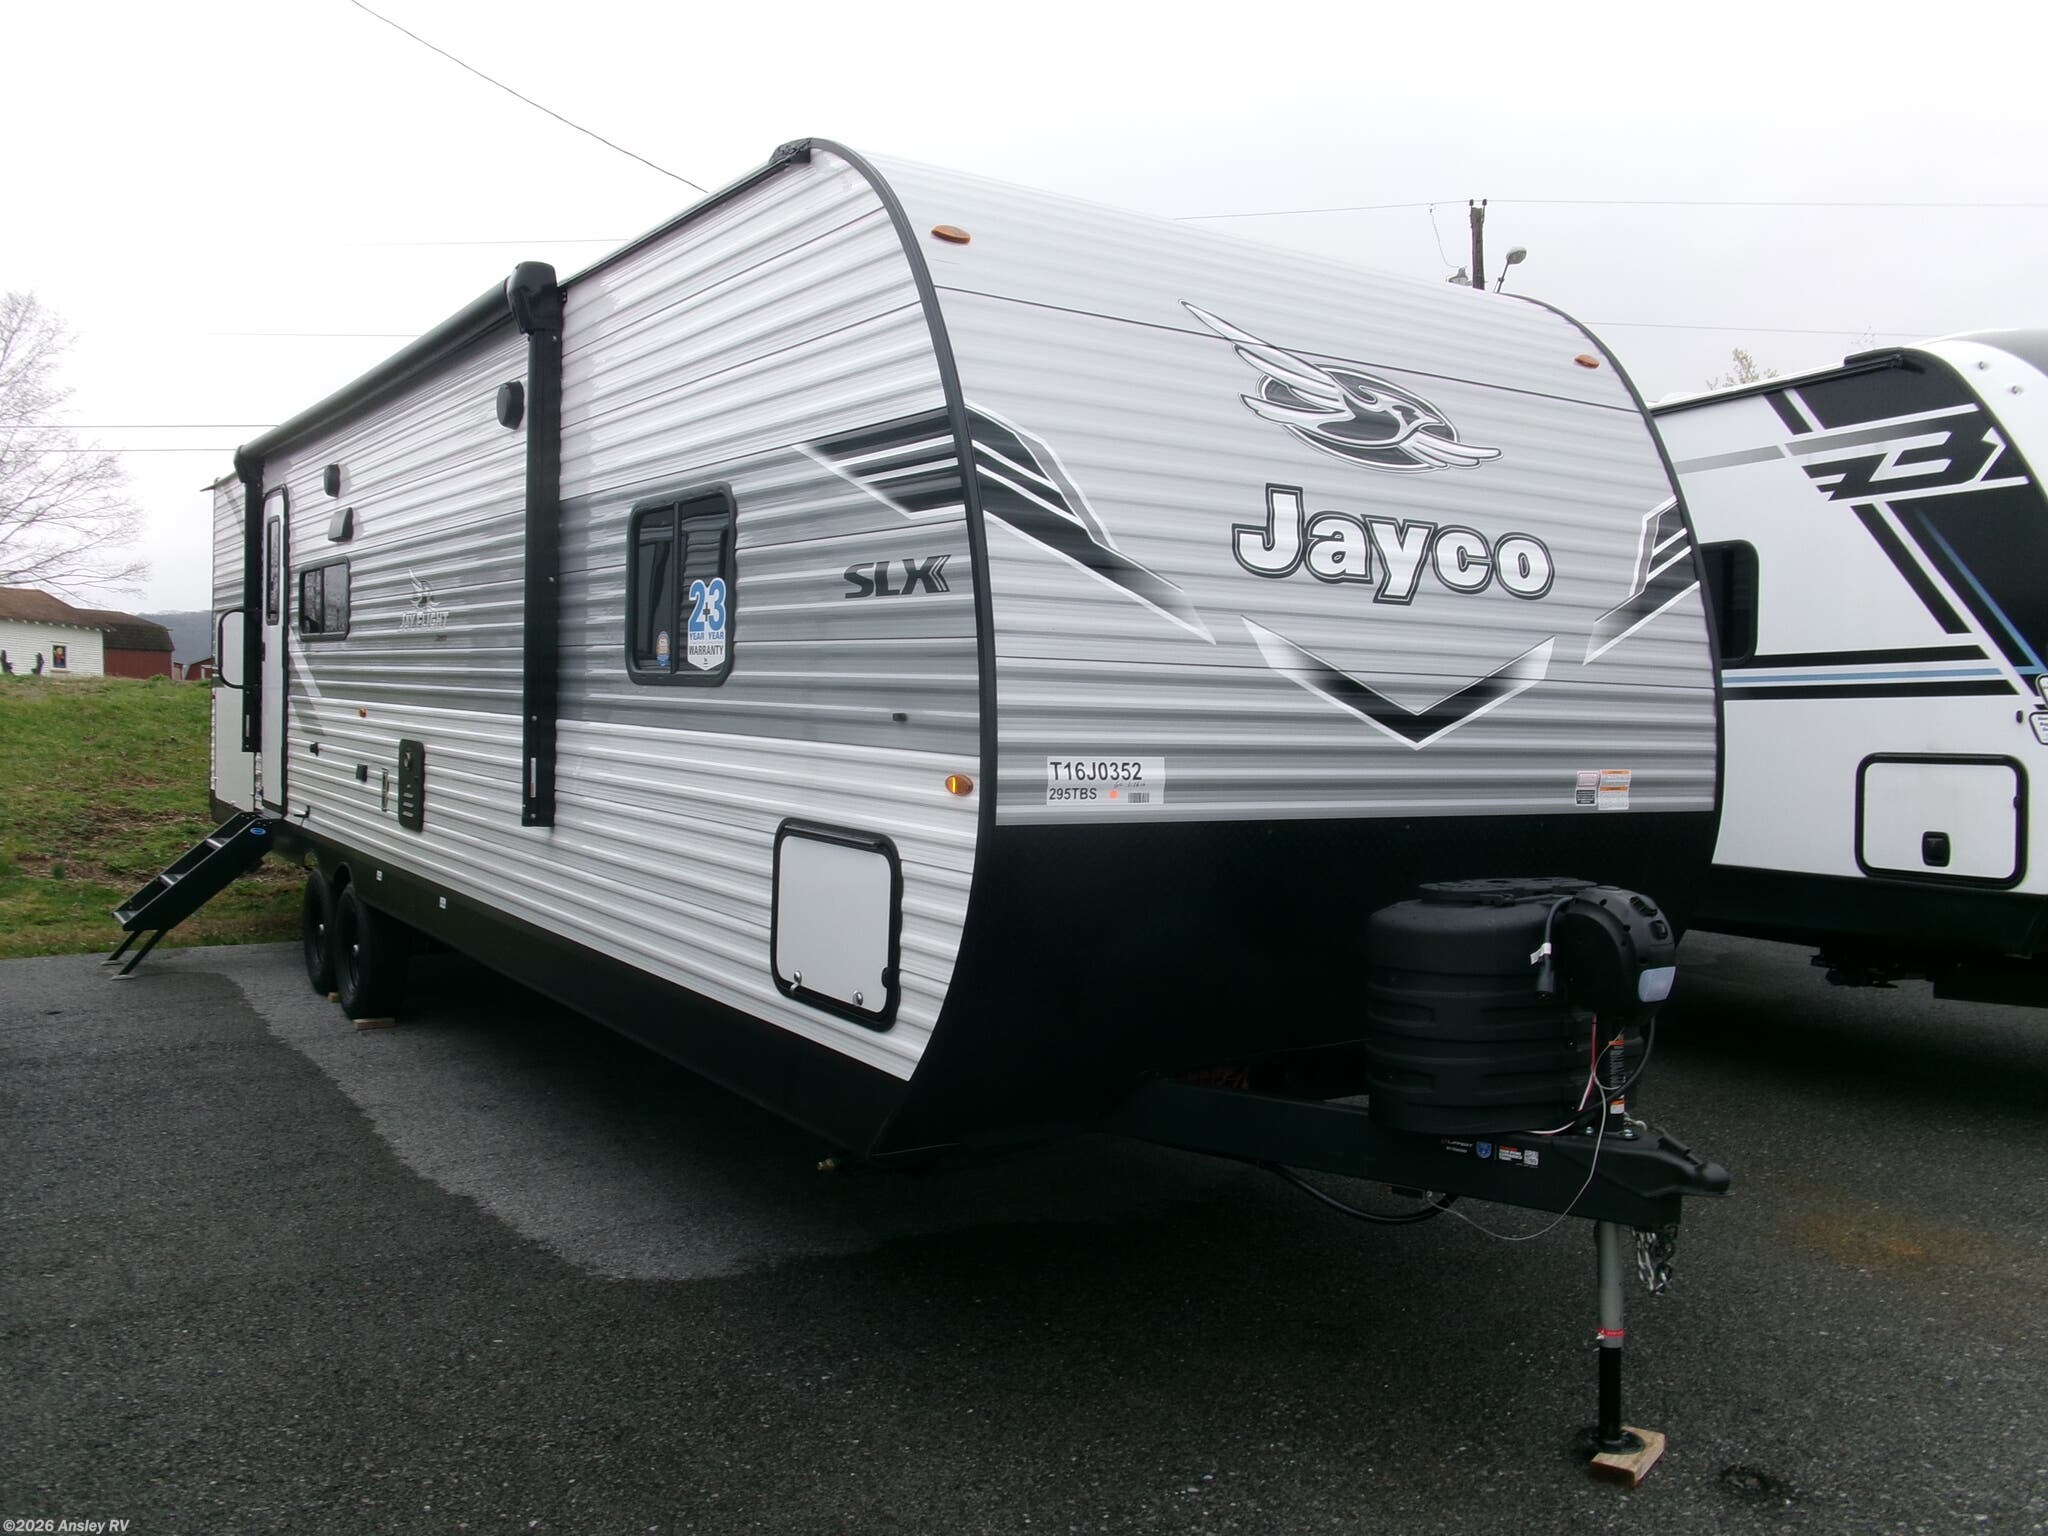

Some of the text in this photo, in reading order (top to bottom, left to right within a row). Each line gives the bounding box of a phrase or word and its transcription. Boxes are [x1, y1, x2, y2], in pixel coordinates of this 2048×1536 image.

[1231, 482, 1555, 606] Jayco
[843, 554, 952, 599] SLX
[689, 631, 724, 641] YEAR YEAR
[689, 644, 724, 655] WARRANTY
[1050, 761, 1143, 781] T16J0352
[1049, 787, 1097, 800] 295TBS
